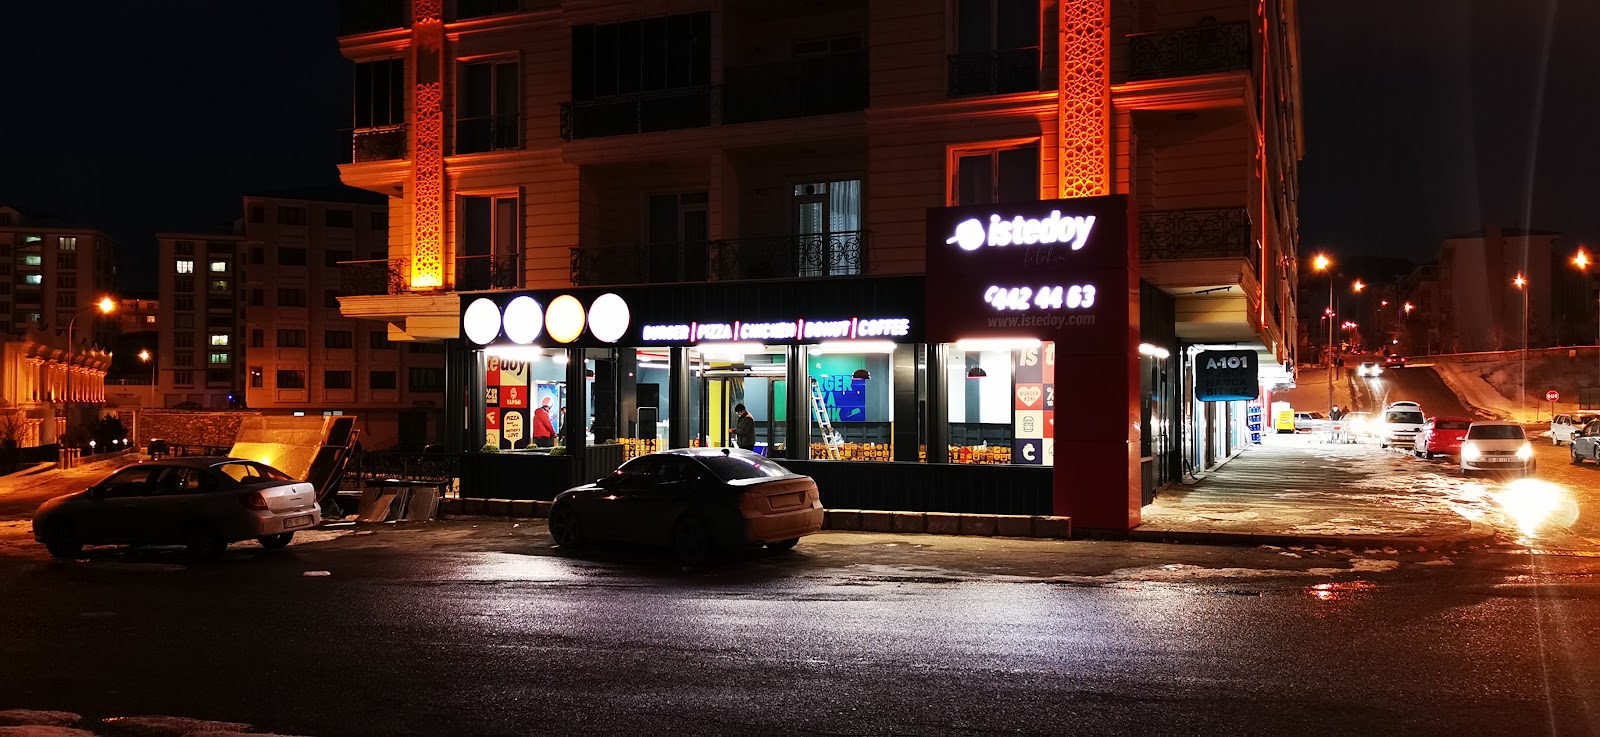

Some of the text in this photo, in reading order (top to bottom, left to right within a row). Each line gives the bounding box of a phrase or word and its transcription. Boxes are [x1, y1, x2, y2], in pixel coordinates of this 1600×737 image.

[988, 210, 1096, 250] istedoy
[1035, 286, 1063, 309] 44
[1066, 284, 1096, 308] 63
[643, 318, 910, 341] BURGER PIZZA CHICKEN DONUT COFFEE
[988, 313, 1096, 330] www.istedoy.com
